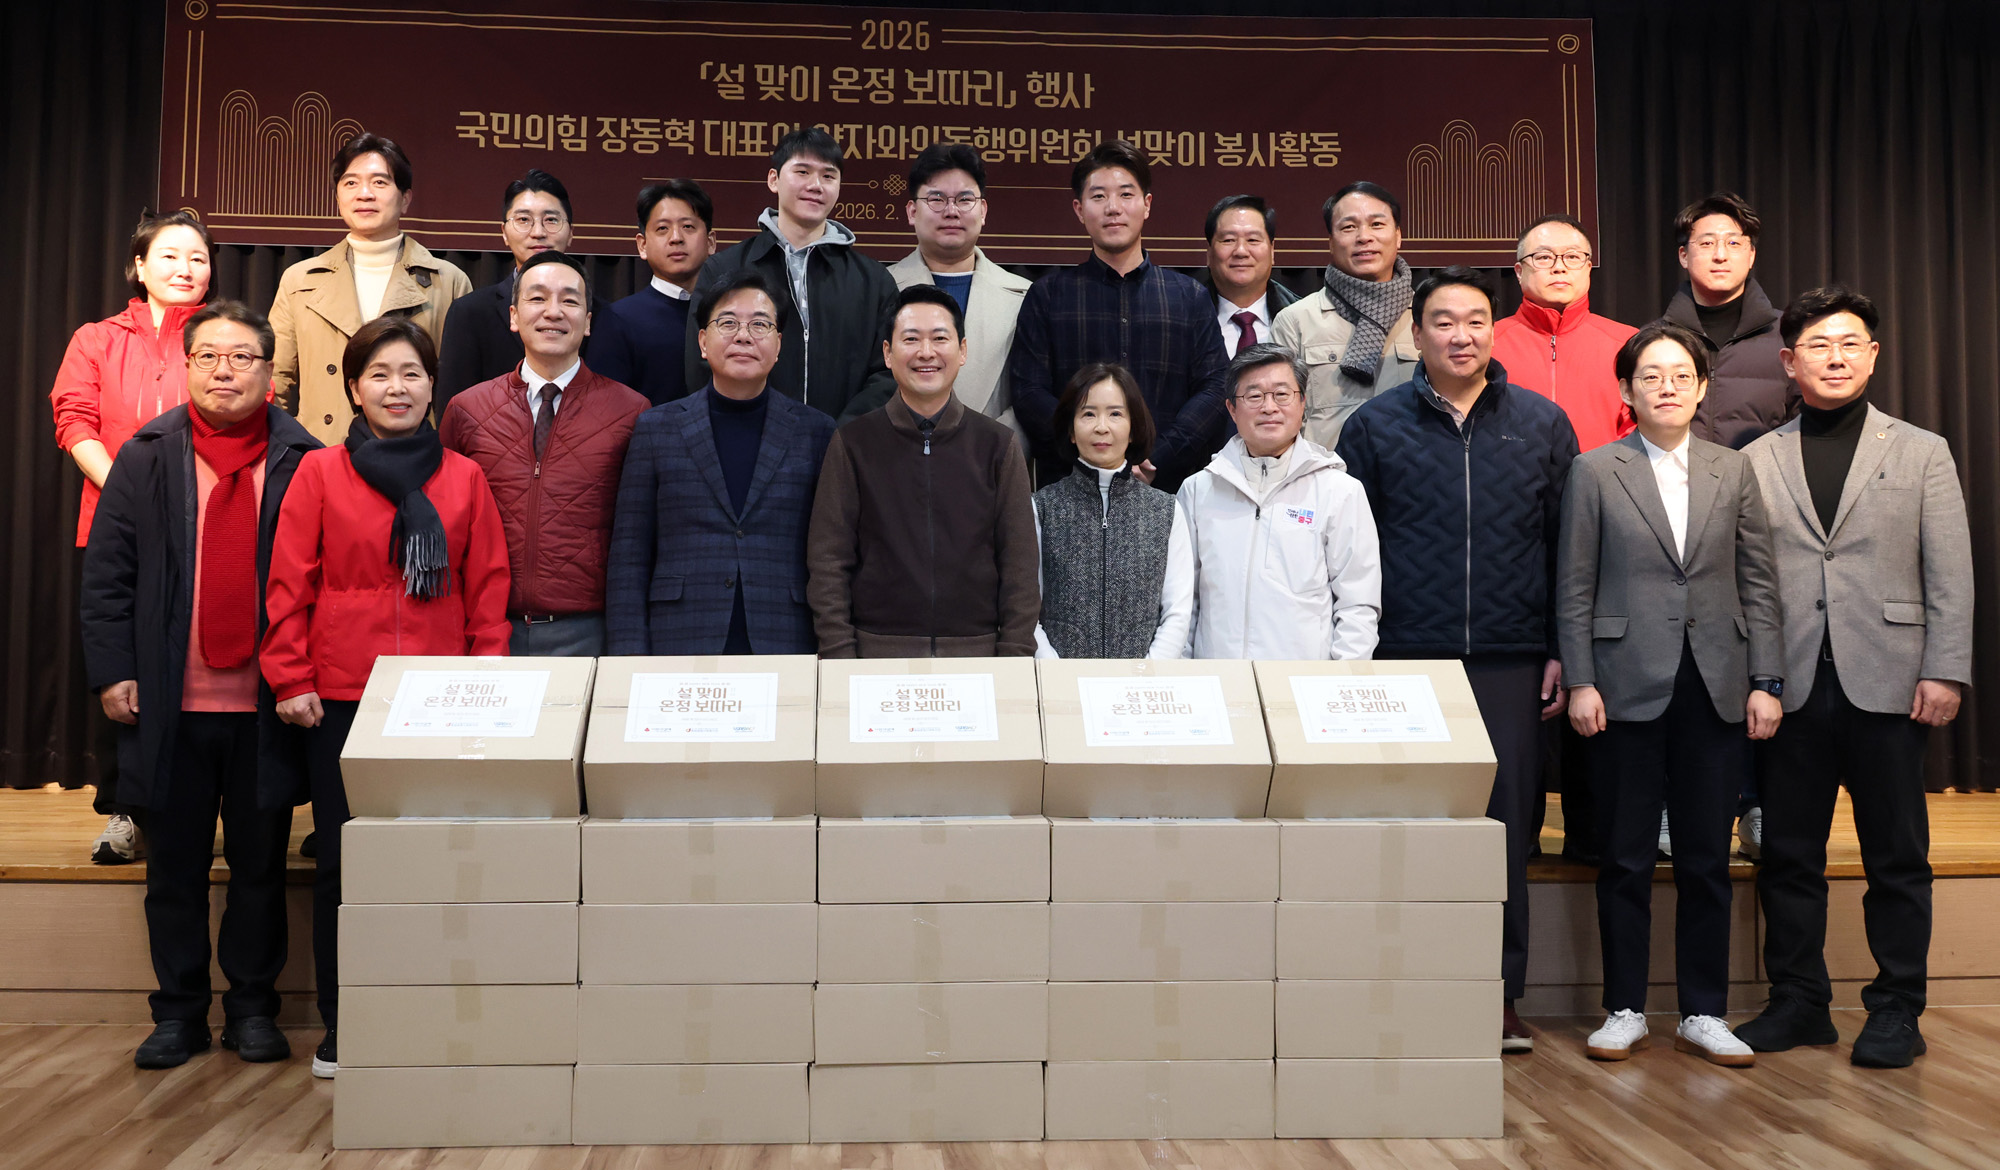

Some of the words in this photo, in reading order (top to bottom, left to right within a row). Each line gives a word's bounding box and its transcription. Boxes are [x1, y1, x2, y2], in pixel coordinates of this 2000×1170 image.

[861, 19, 930, 51] 2026
[700, 61, 746, 100] 「설
[754, 64, 820, 101] 맞이
[828, 66, 895, 104] 온정
[903, 69, 1017, 109] 보따리」
[1026, 72, 1095, 109] 행사
[455, 111, 588, 152] 국민의힘
[596, 117, 695, 155] 장동혁
[1213, 131, 1342, 168] 봉사활동
[834, 202, 880, 220] 2026.
[445, 684, 461, 695] 설
[464, 684, 496, 695] 맞이
[677, 687, 692, 699] 설
[696, 687, 728, 699] 맞이
[895, 688, 910, 700] 설
[914, 688, 945, 699] 맞이
[1338, 689, 1354, 700] 설
[1355, 688, 1388, 700] 맞이
[424, 696, 456, 708] 온정
[458, 696, 508, 708] 보따리
[1125, 691, 1140, 703] 설
[1143, 691, 1174, 703] 맞이
[658, 700, 691, 713] 온정
[693, 700, 742, 712] 보따리
[879, 700, 910, 712] 온정
[913, 700, 961, 712] 보따리
[1111, 703, 1142, 715] 온정
[1145, 703, 1193, 715] 보따리
[1326, 701, 1358, 713] 온정
[1359, 701, 1408, 713] 보따리
